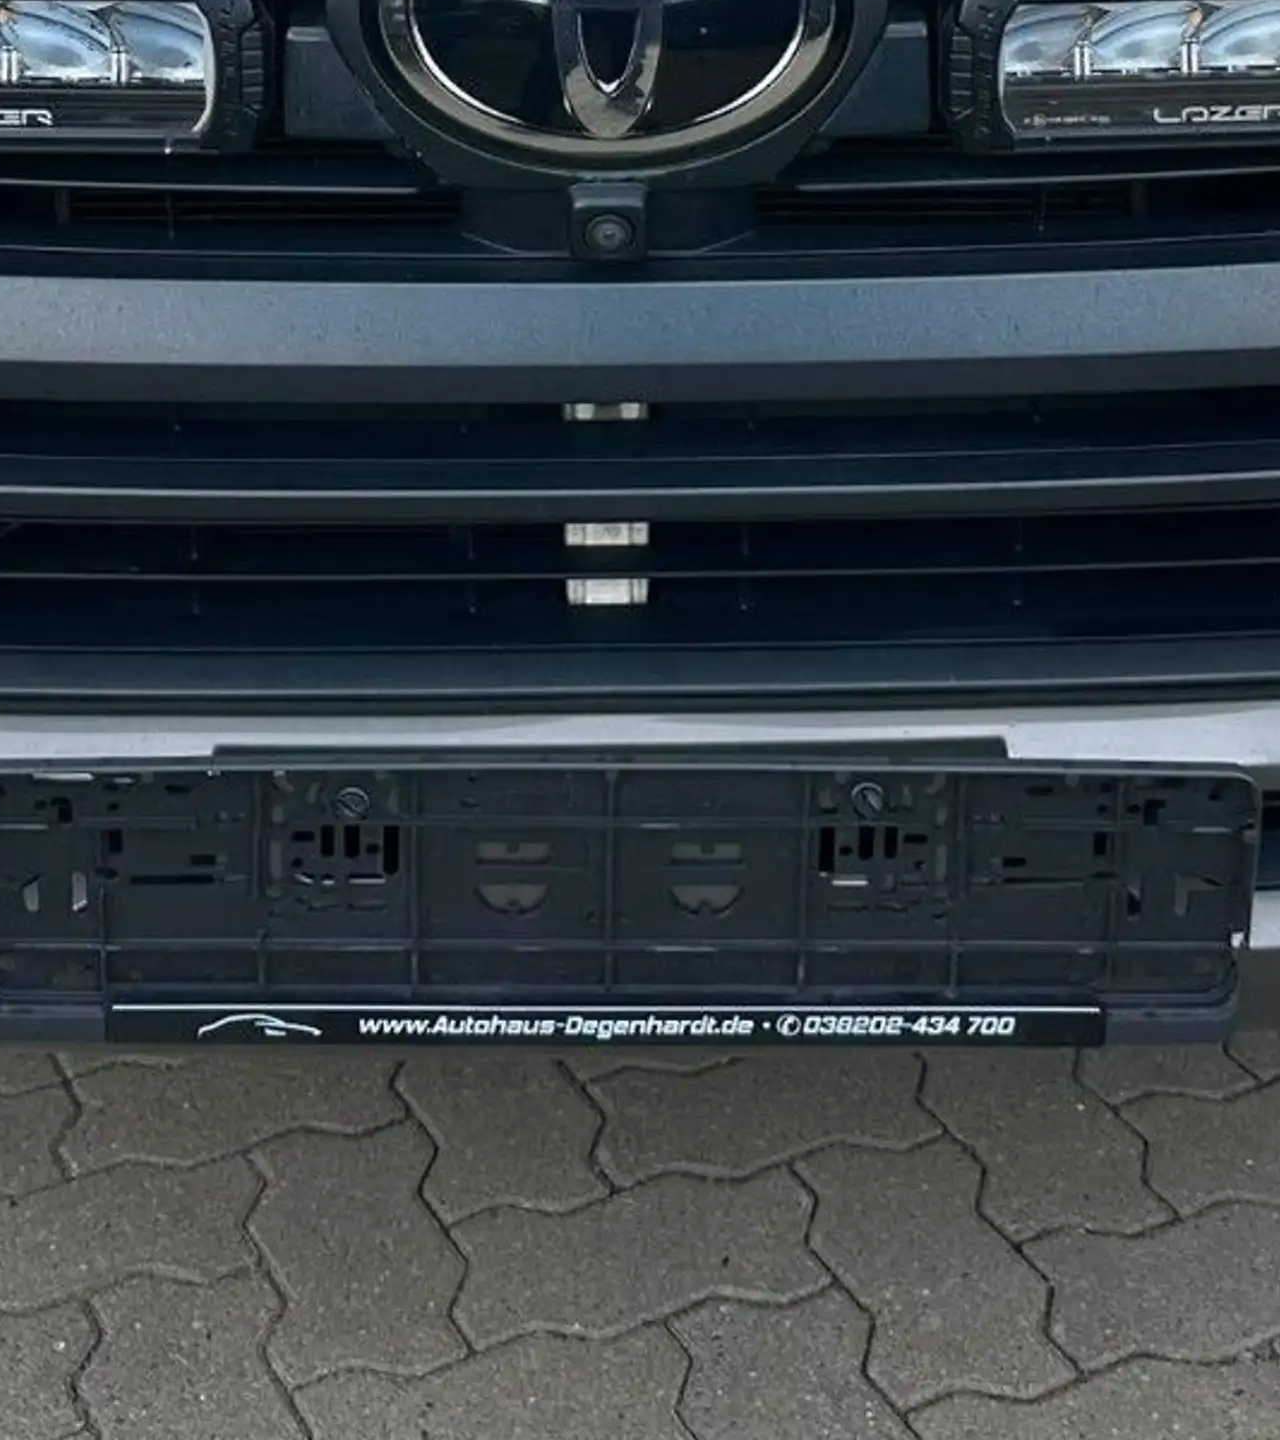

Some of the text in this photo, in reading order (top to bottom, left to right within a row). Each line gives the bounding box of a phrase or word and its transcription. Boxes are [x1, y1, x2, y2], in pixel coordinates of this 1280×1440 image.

[358, 1015, 1016, 1040] www.Autohaus-Degenhardt.de 038202-434 700
